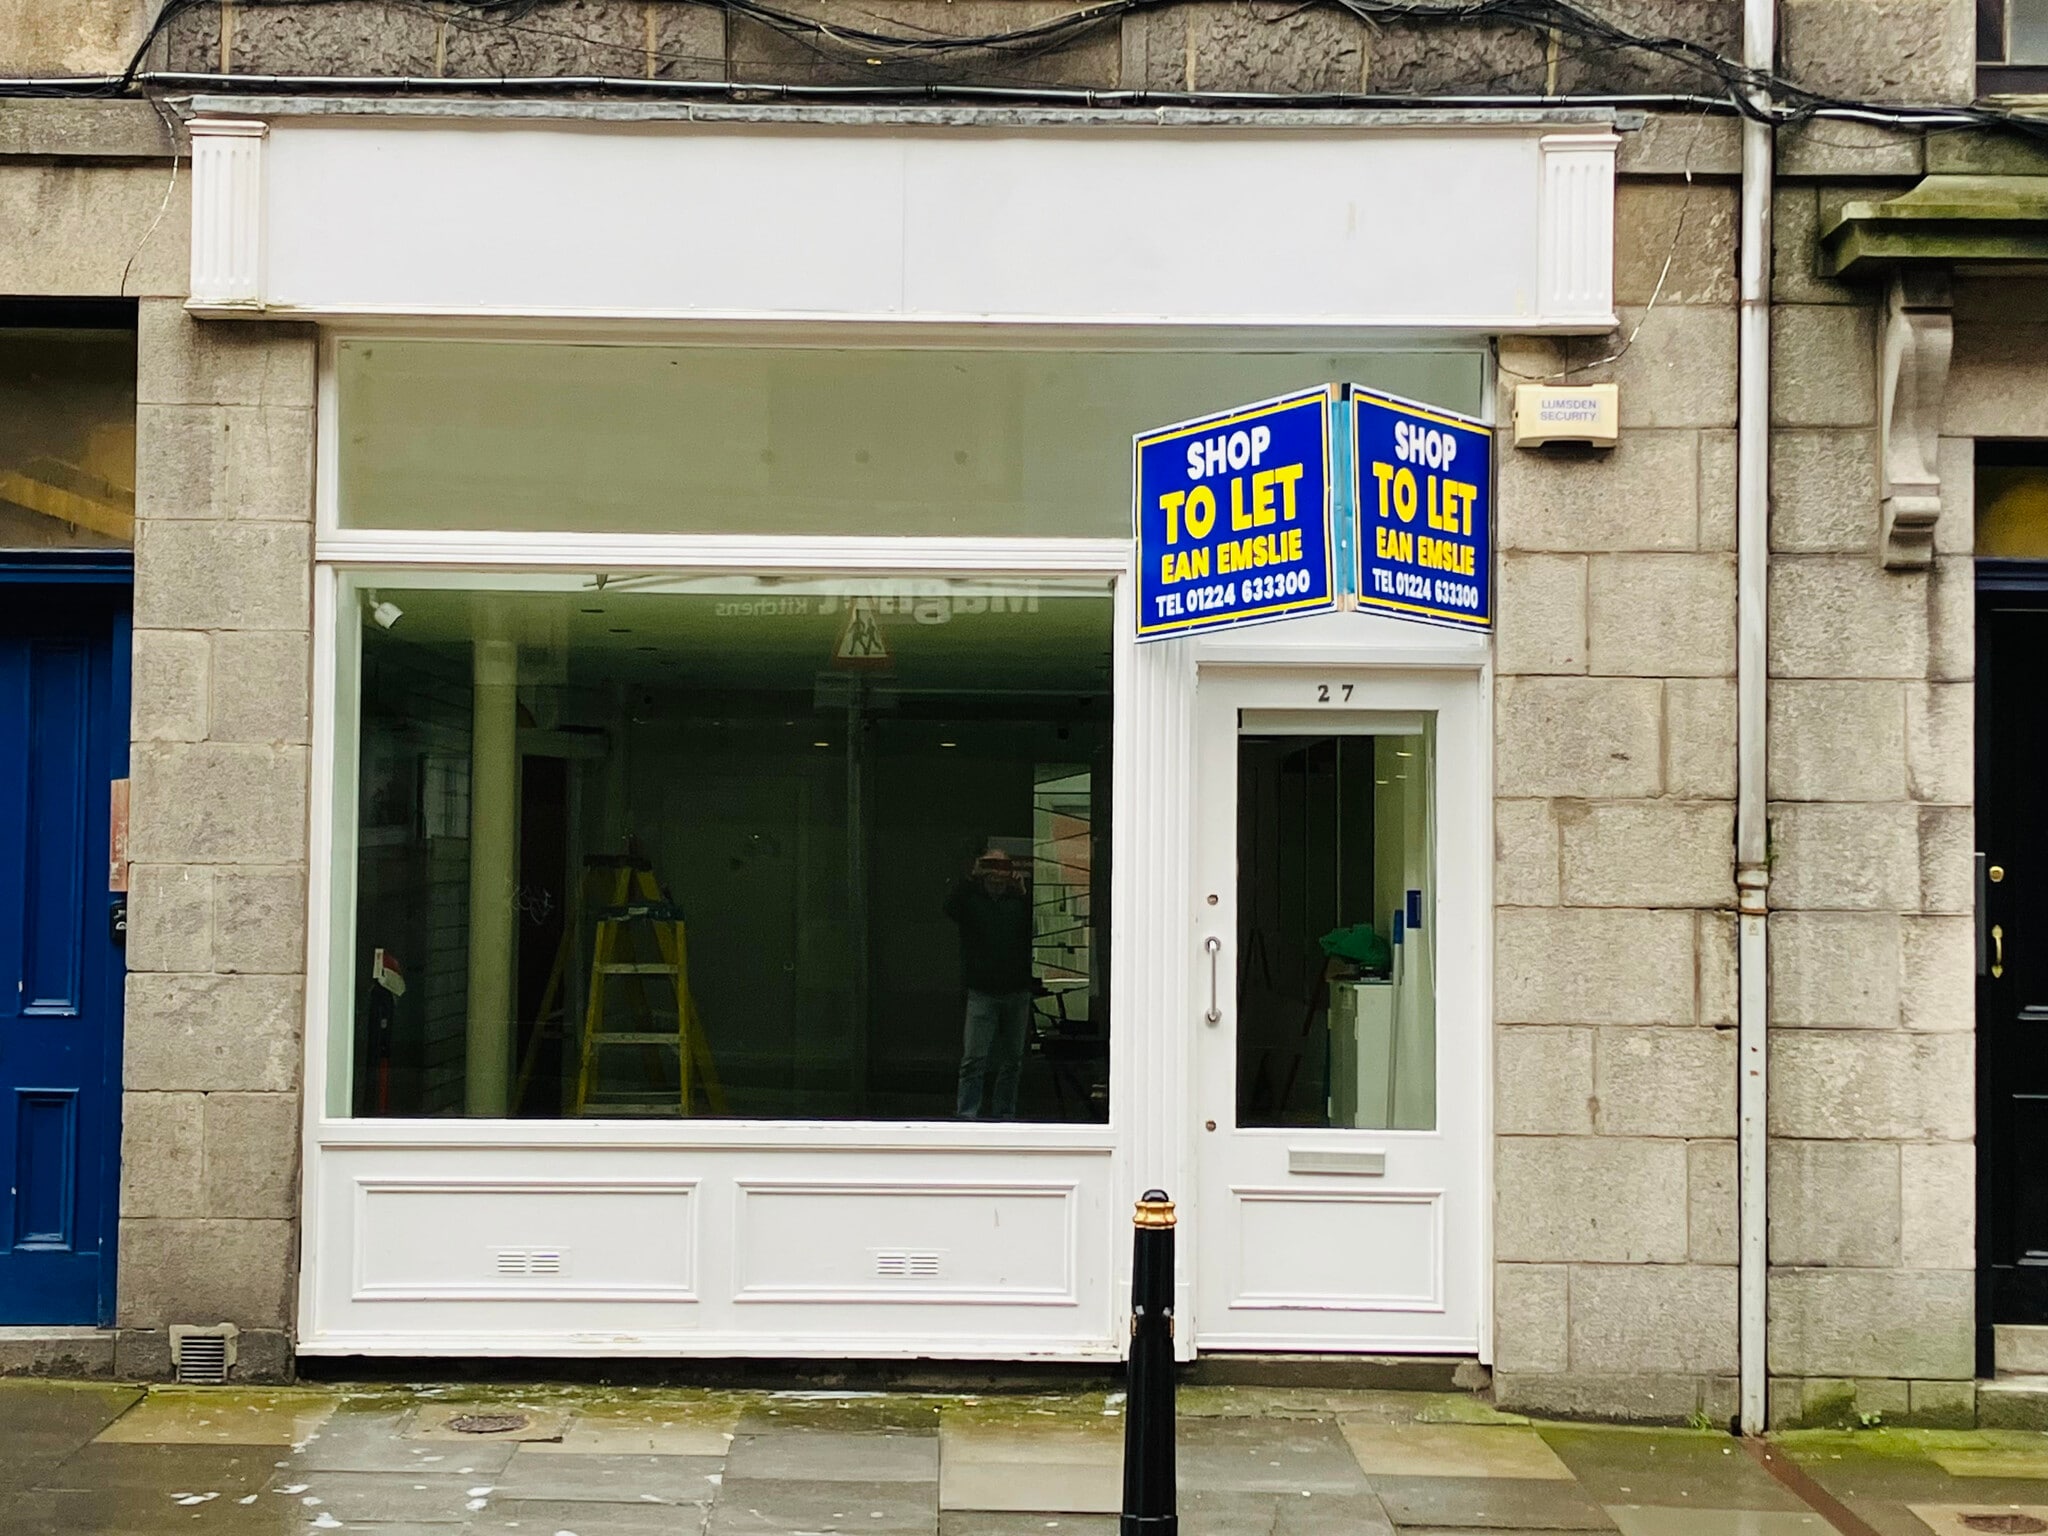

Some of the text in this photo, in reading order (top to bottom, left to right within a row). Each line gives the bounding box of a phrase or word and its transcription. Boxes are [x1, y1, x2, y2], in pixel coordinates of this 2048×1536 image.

[1540, 411, 1597, 421] SECURITY
[1541, 400, 1597, 409] LUMSDEN
[1187, 425, 1271, 480] SHOP
[1394, 420, 1457, 472] SHOP
[1159, 462, 1304, 545] TO LET
[1372, 461, 1478, 537] TO LET
[1161, 528, 1303, 585] EAN EMSLIE
[1376, 526, 1476, 577] EAN EMSLIE
[1155, 568, 1311, 618] TEL 01224 633300
[1372, 567, 1479, 610] TEL 01224 633300
